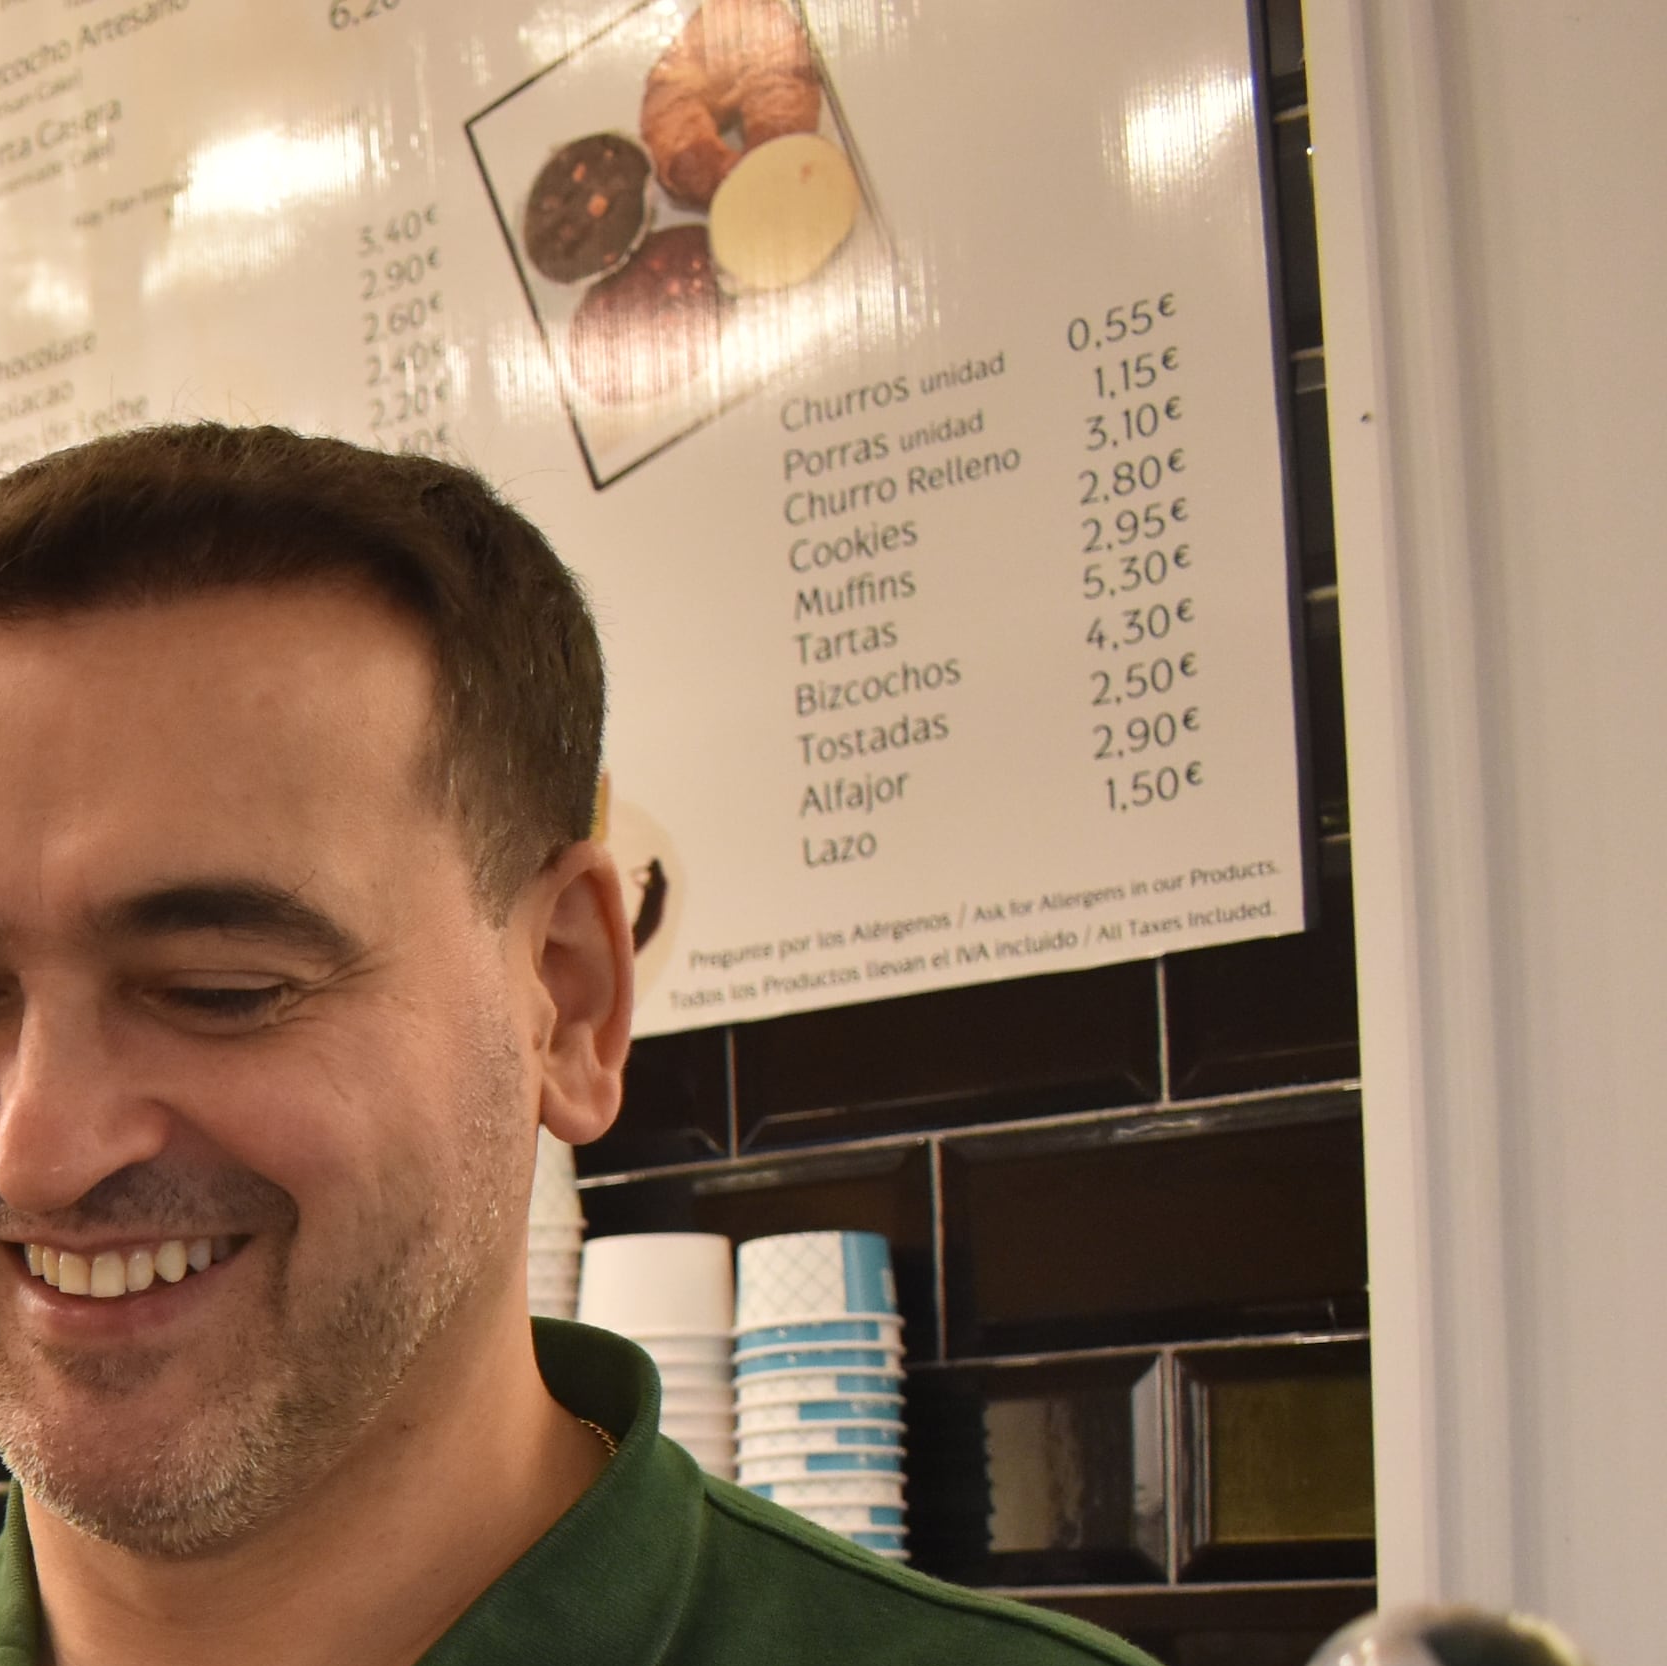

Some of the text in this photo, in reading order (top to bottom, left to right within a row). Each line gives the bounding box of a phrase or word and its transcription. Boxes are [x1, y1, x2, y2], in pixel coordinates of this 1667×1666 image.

[779, 375, 911, 433] Churros
[919, 351, 1007, 396] unidad
[782, 432, 890, 482] Porras
[899, 407, 986, 453] unidad
[783, 476, 898, 527] Churro
[907, 447, 1022, 496] Relleno
[788, 520, 919, 574] Cookies
[793, 570, 917, 622] Muffins
[792, 620, 899, 666] Tartas
[795, 657, 962, 718] Bizcochos
[798, 712, 950, 766] Tostadas
[798, 771, 911, 820] Alfajor
[801, 831, 878, 869] Lazo
[974, 904, 1005, 923] Ask
[1038, 880, 1126, 912] Allergens
[1152, 873, 1183, 893] our
[763, 965, 861, 996] Productos
[995, 930, 1079, 960] incluido
[1128, 914, 1183, 938] Taxes
